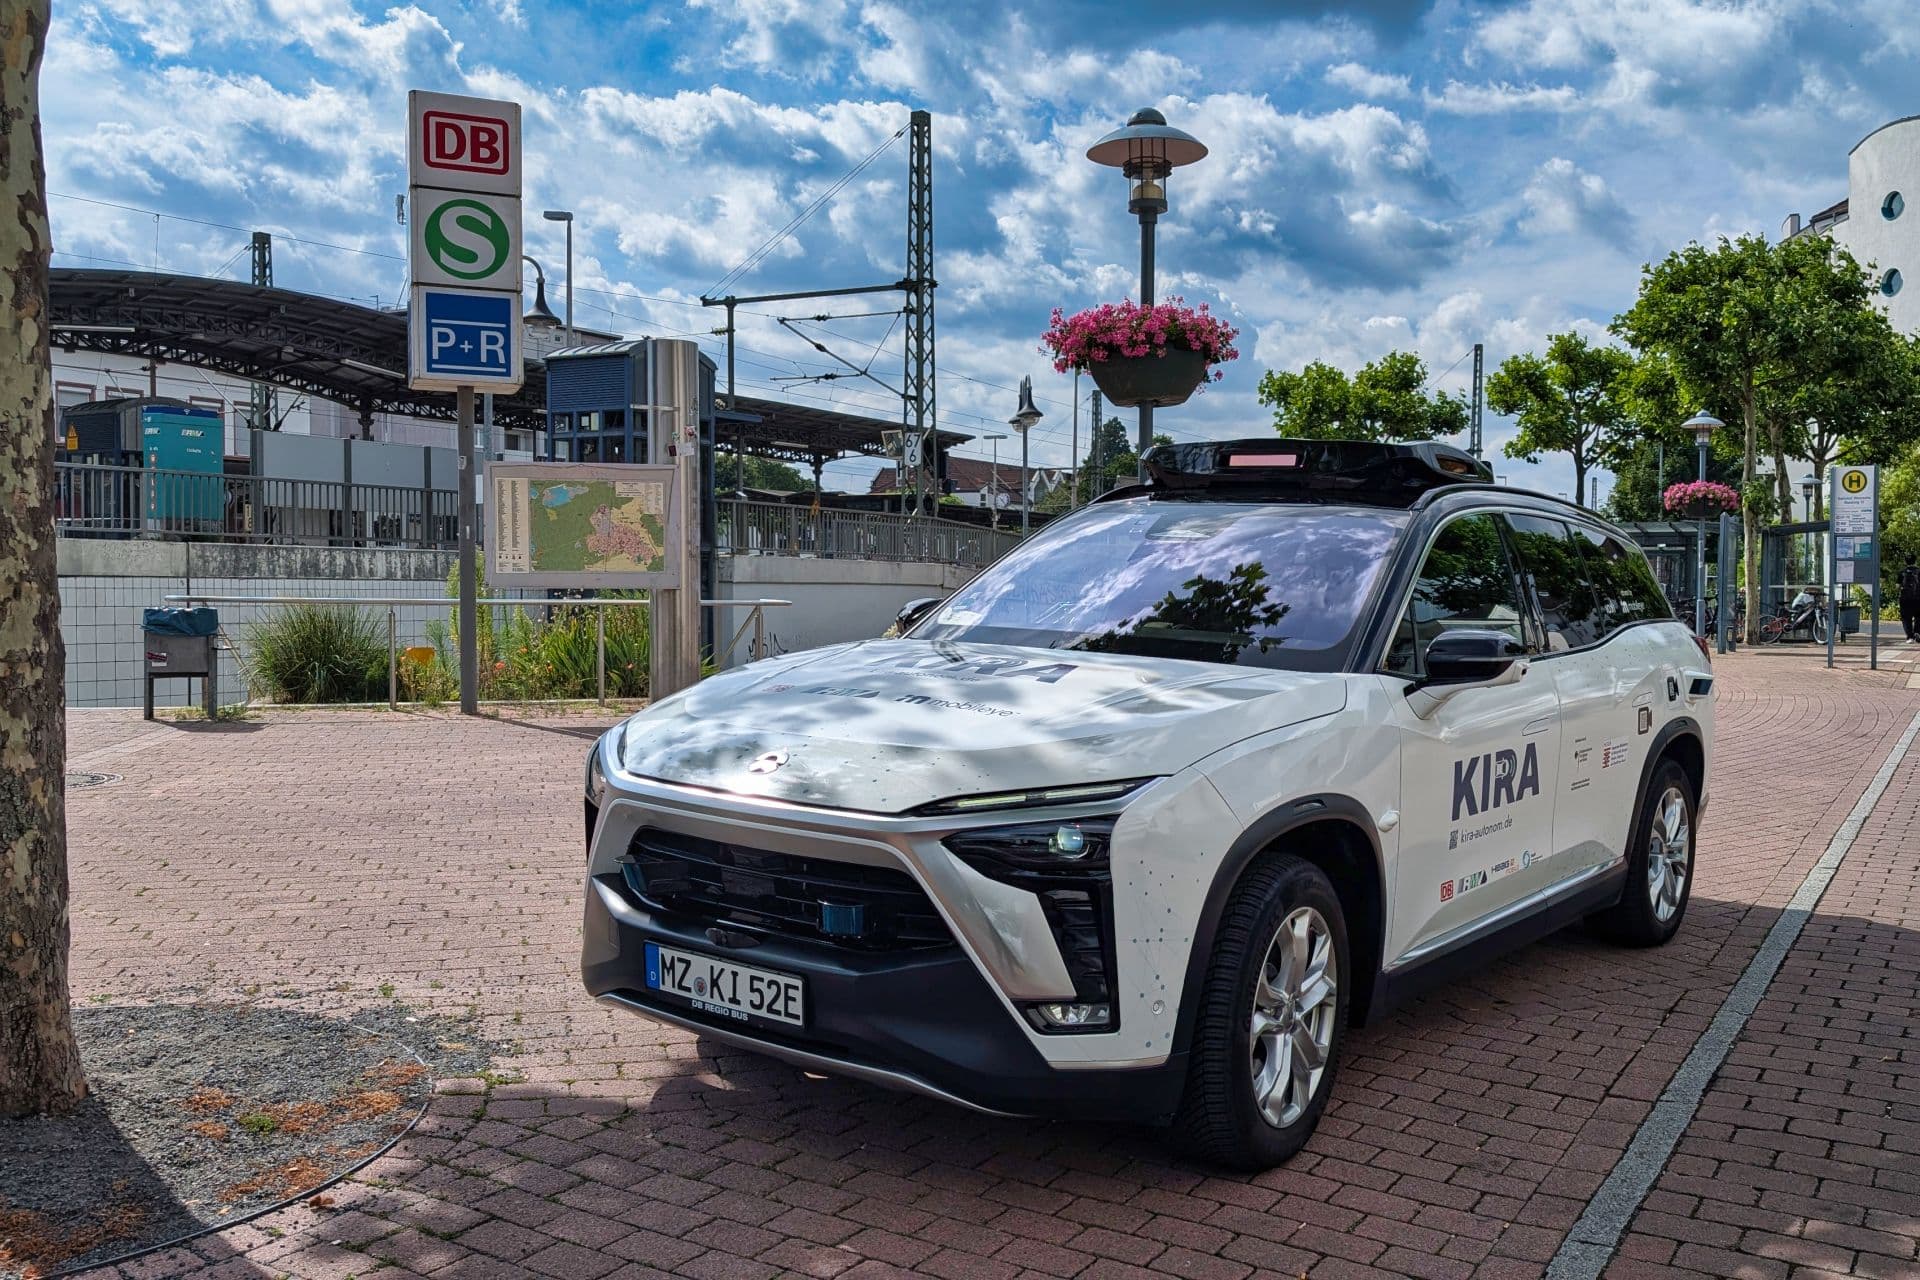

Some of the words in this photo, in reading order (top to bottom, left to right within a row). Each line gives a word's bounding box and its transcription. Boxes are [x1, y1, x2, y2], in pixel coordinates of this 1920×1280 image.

[435, 121, 500, 165] DB
[439, 205, 496, 274] S
[905, 434, 921, 448] 67
[909, 449, 917, 463] 6
[1848, 475, 1861, 488] H
[929, 698, 1016, 717] mobileye
[1451, 742, 1540, 821] KIRA
[1460, 815, 1513, 844] kira-autonom.de
[1441, 882, 1453, 900] DB
[650, 971, 657, 981] D
[660, 953, 692, 993] MZ
[710, 965, 741, 1006] KI
[749, 975, 801, 1021] 52E
[691, 999, 703, 1010] DB
[704, 1003, 730, 1017] REGIO
[731, 1010, 749, 1021] BUS
